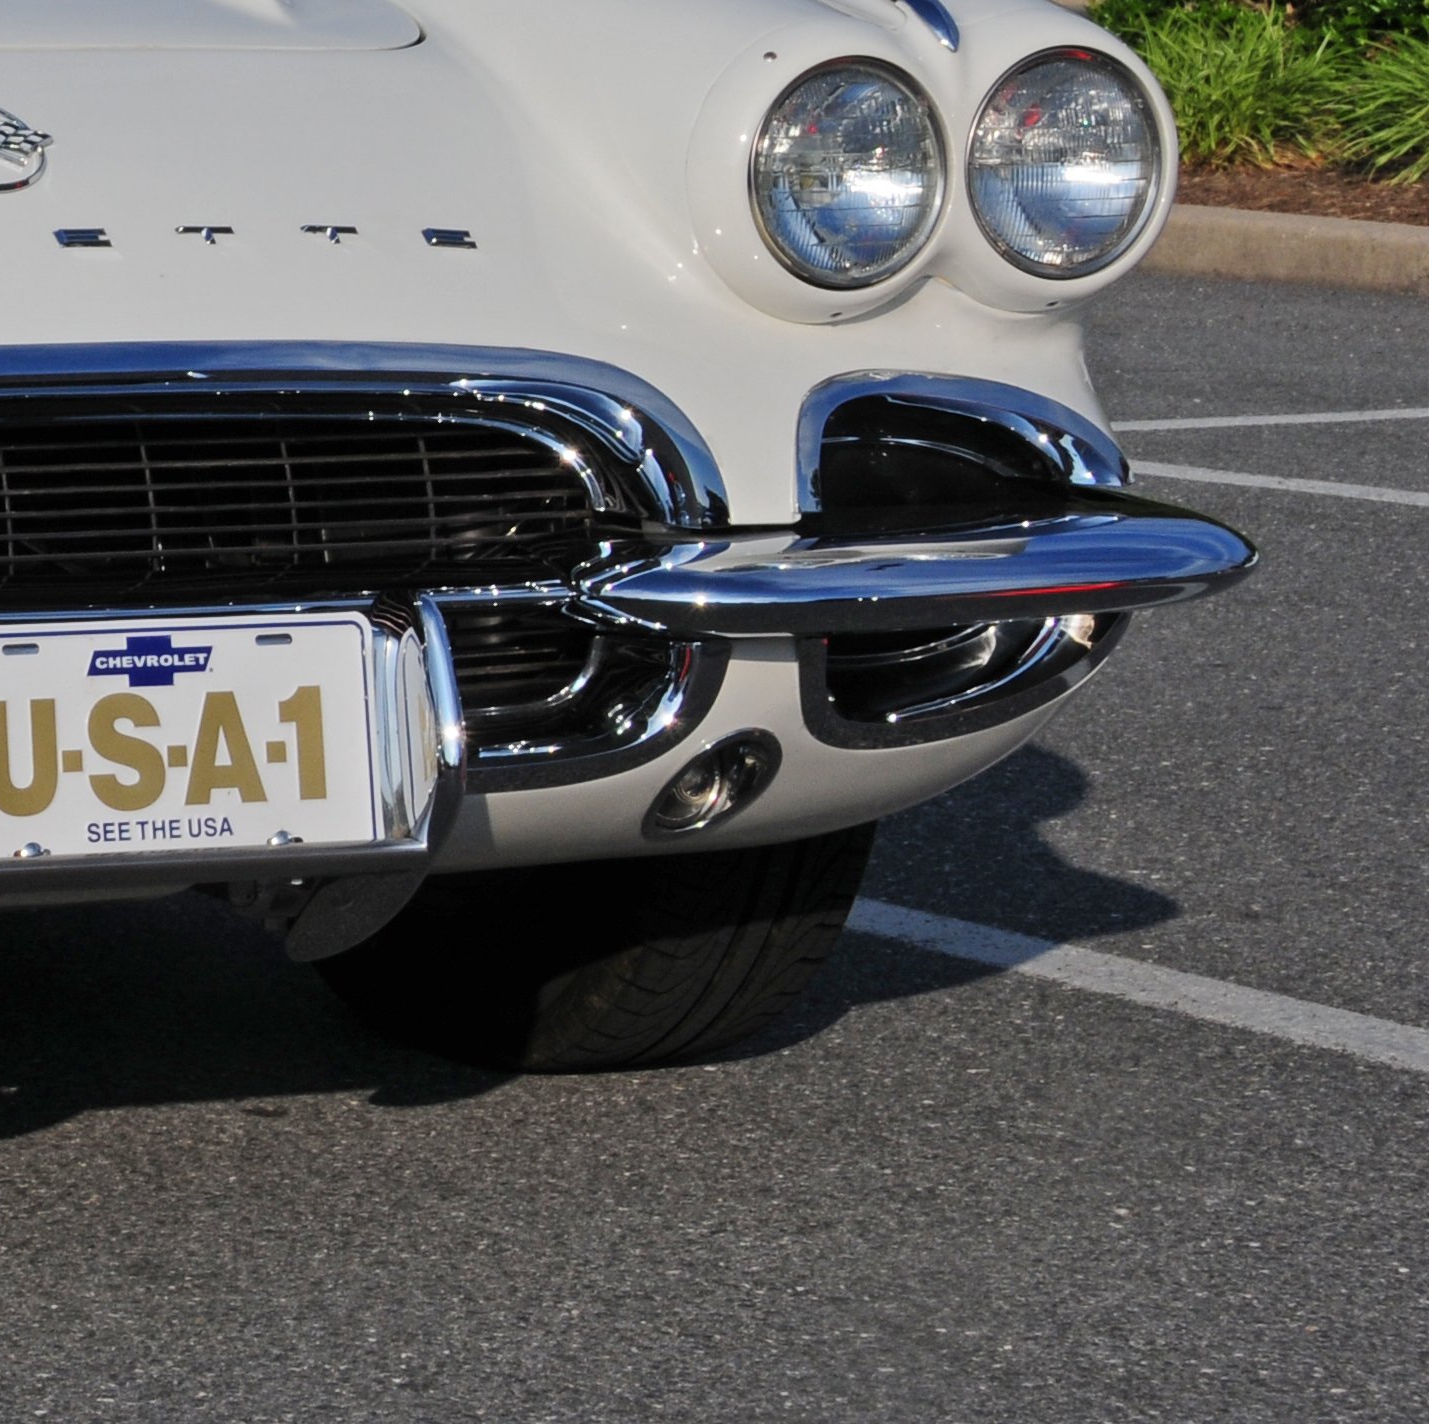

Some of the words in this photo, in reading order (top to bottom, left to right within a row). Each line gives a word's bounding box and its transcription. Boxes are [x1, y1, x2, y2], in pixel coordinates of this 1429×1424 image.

[94, 651, 208, 671] CHEVROLET
[86, 821, 131, 844] SEE
[140, 818, 182, 840] THE
[187, 816, 234, 838] USA
